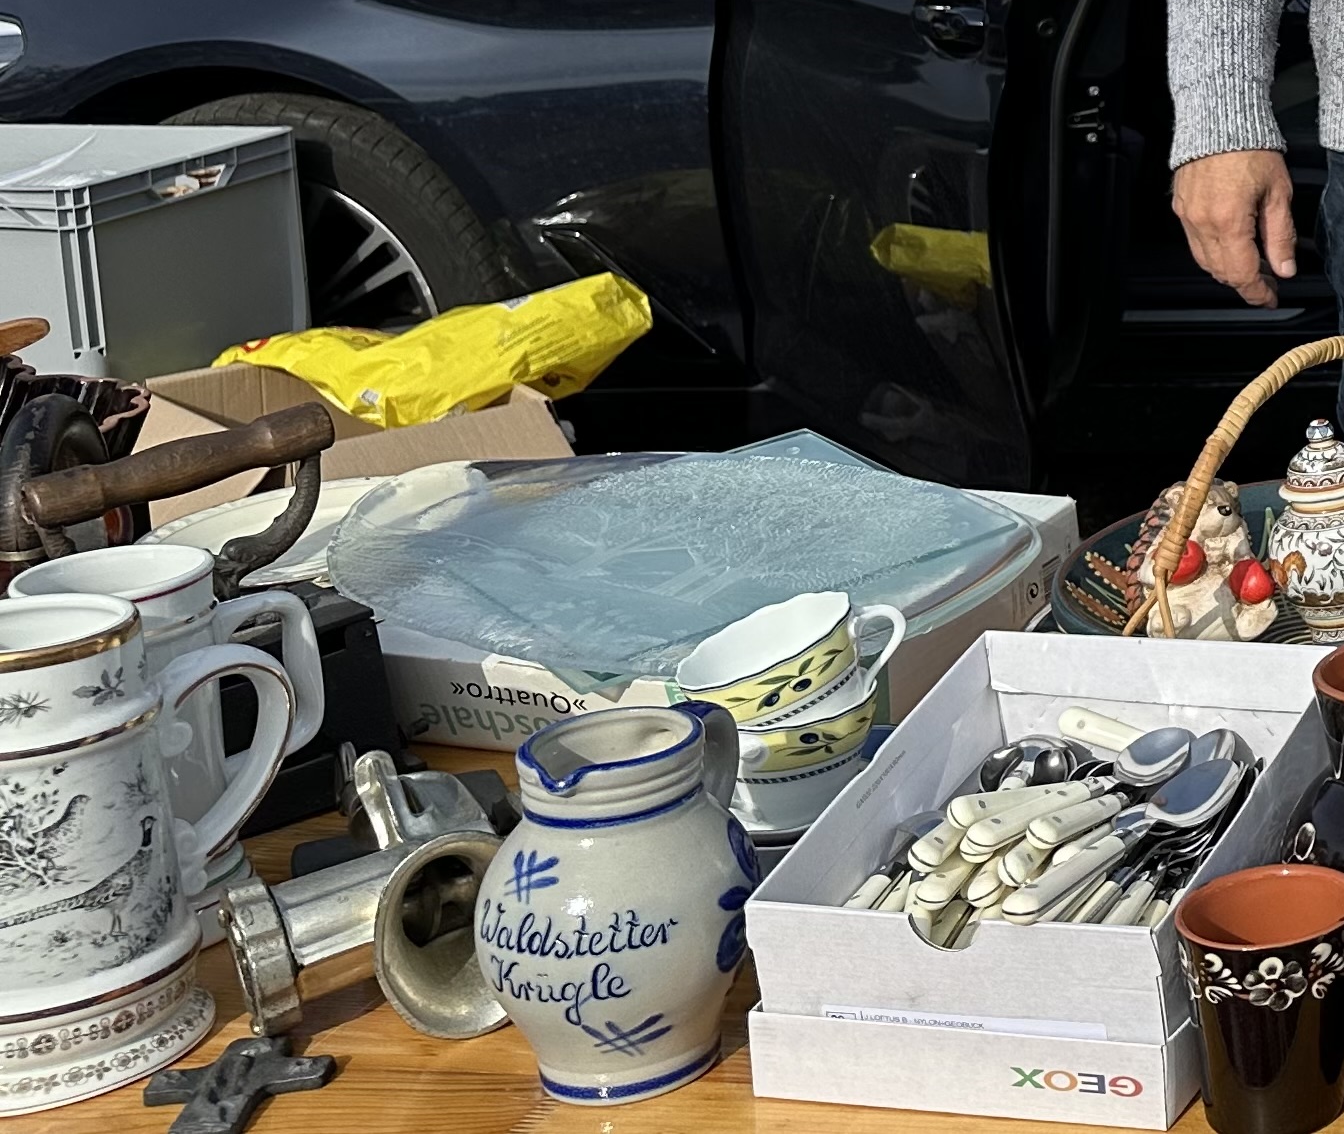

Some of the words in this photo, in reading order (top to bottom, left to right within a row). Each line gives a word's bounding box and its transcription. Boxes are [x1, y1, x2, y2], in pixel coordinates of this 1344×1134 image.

[480, 898, 679, 960] Waldstetter
[490, 954, 632, 1026] Krügle
[1009, 1066, 1144, 1098] GEOX
